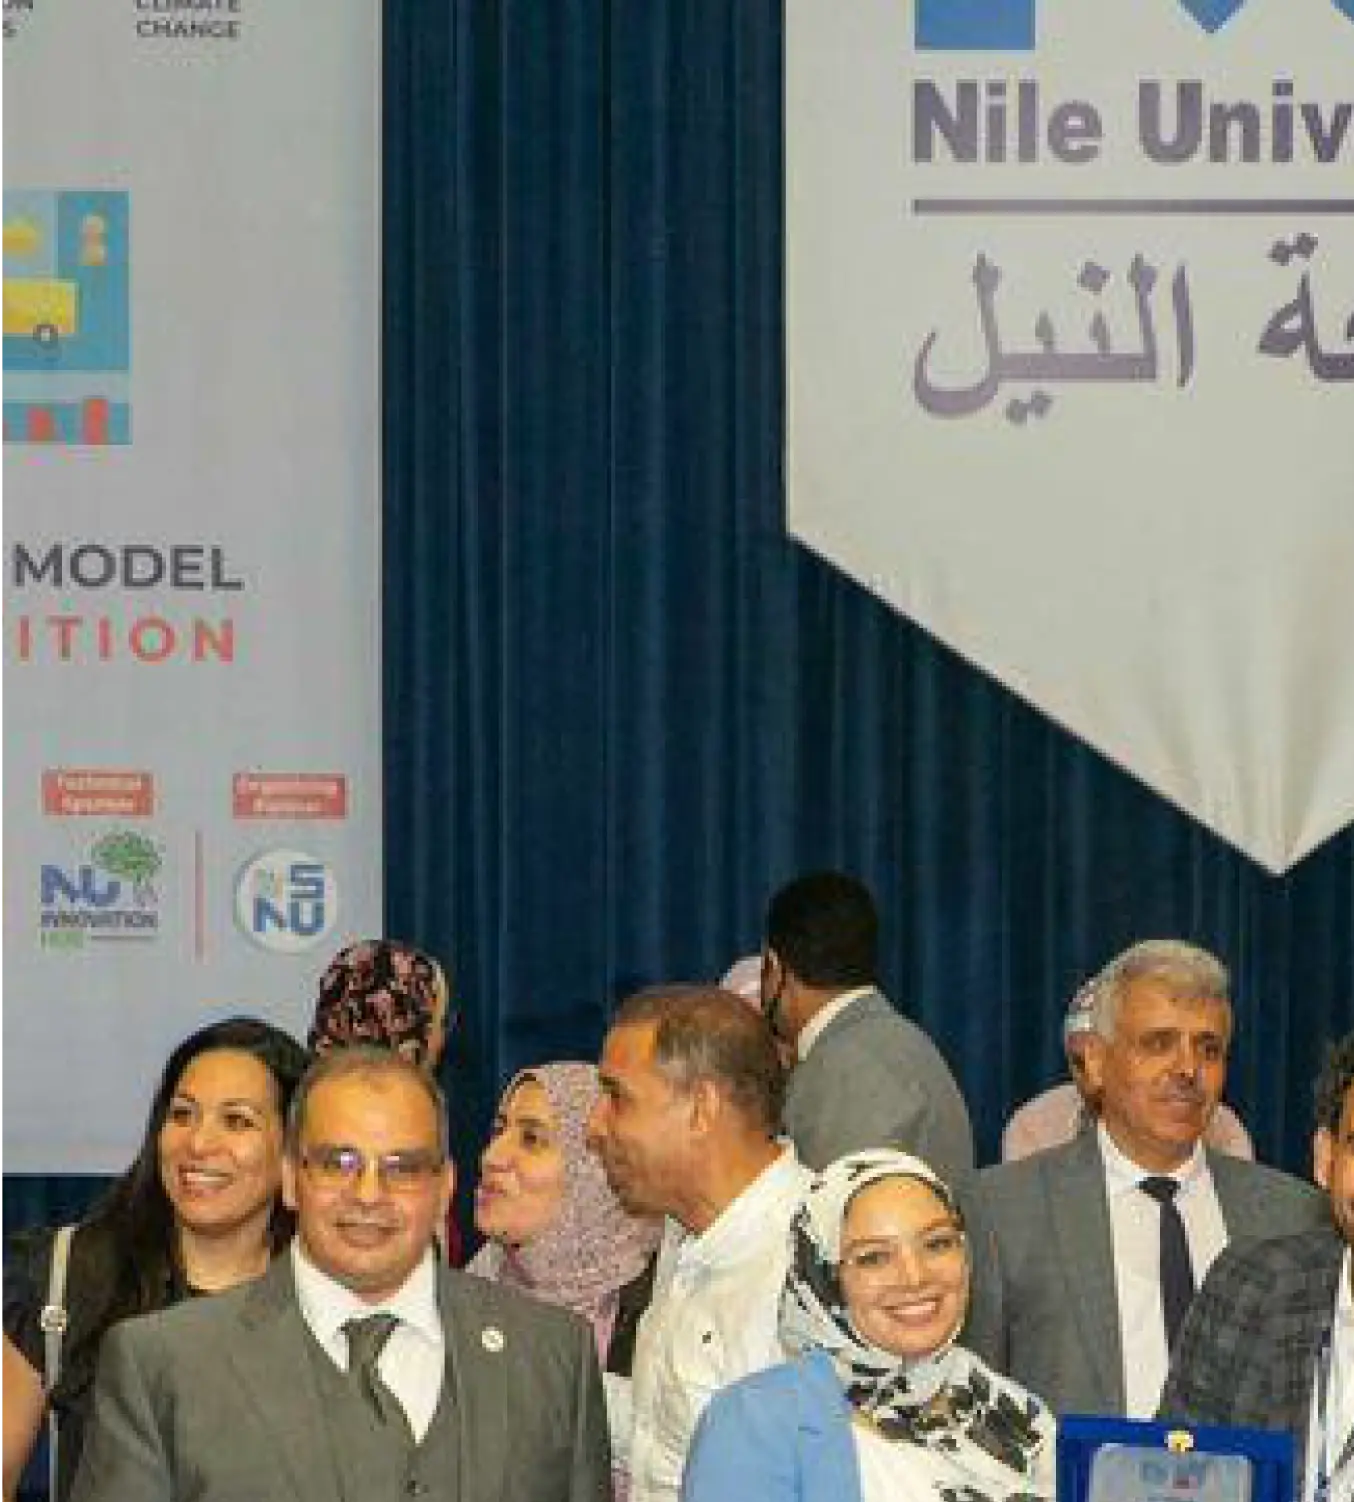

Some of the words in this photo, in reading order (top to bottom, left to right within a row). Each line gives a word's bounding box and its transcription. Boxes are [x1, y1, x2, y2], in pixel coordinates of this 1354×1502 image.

[136, 20, 240, 38] CHANGE
[912, 80, 1103, 164] Nile
[912, 252, 1196, 425] النيل
[12, 543, 246, 591] MODEL
[40, 864, 122, 906] NU
